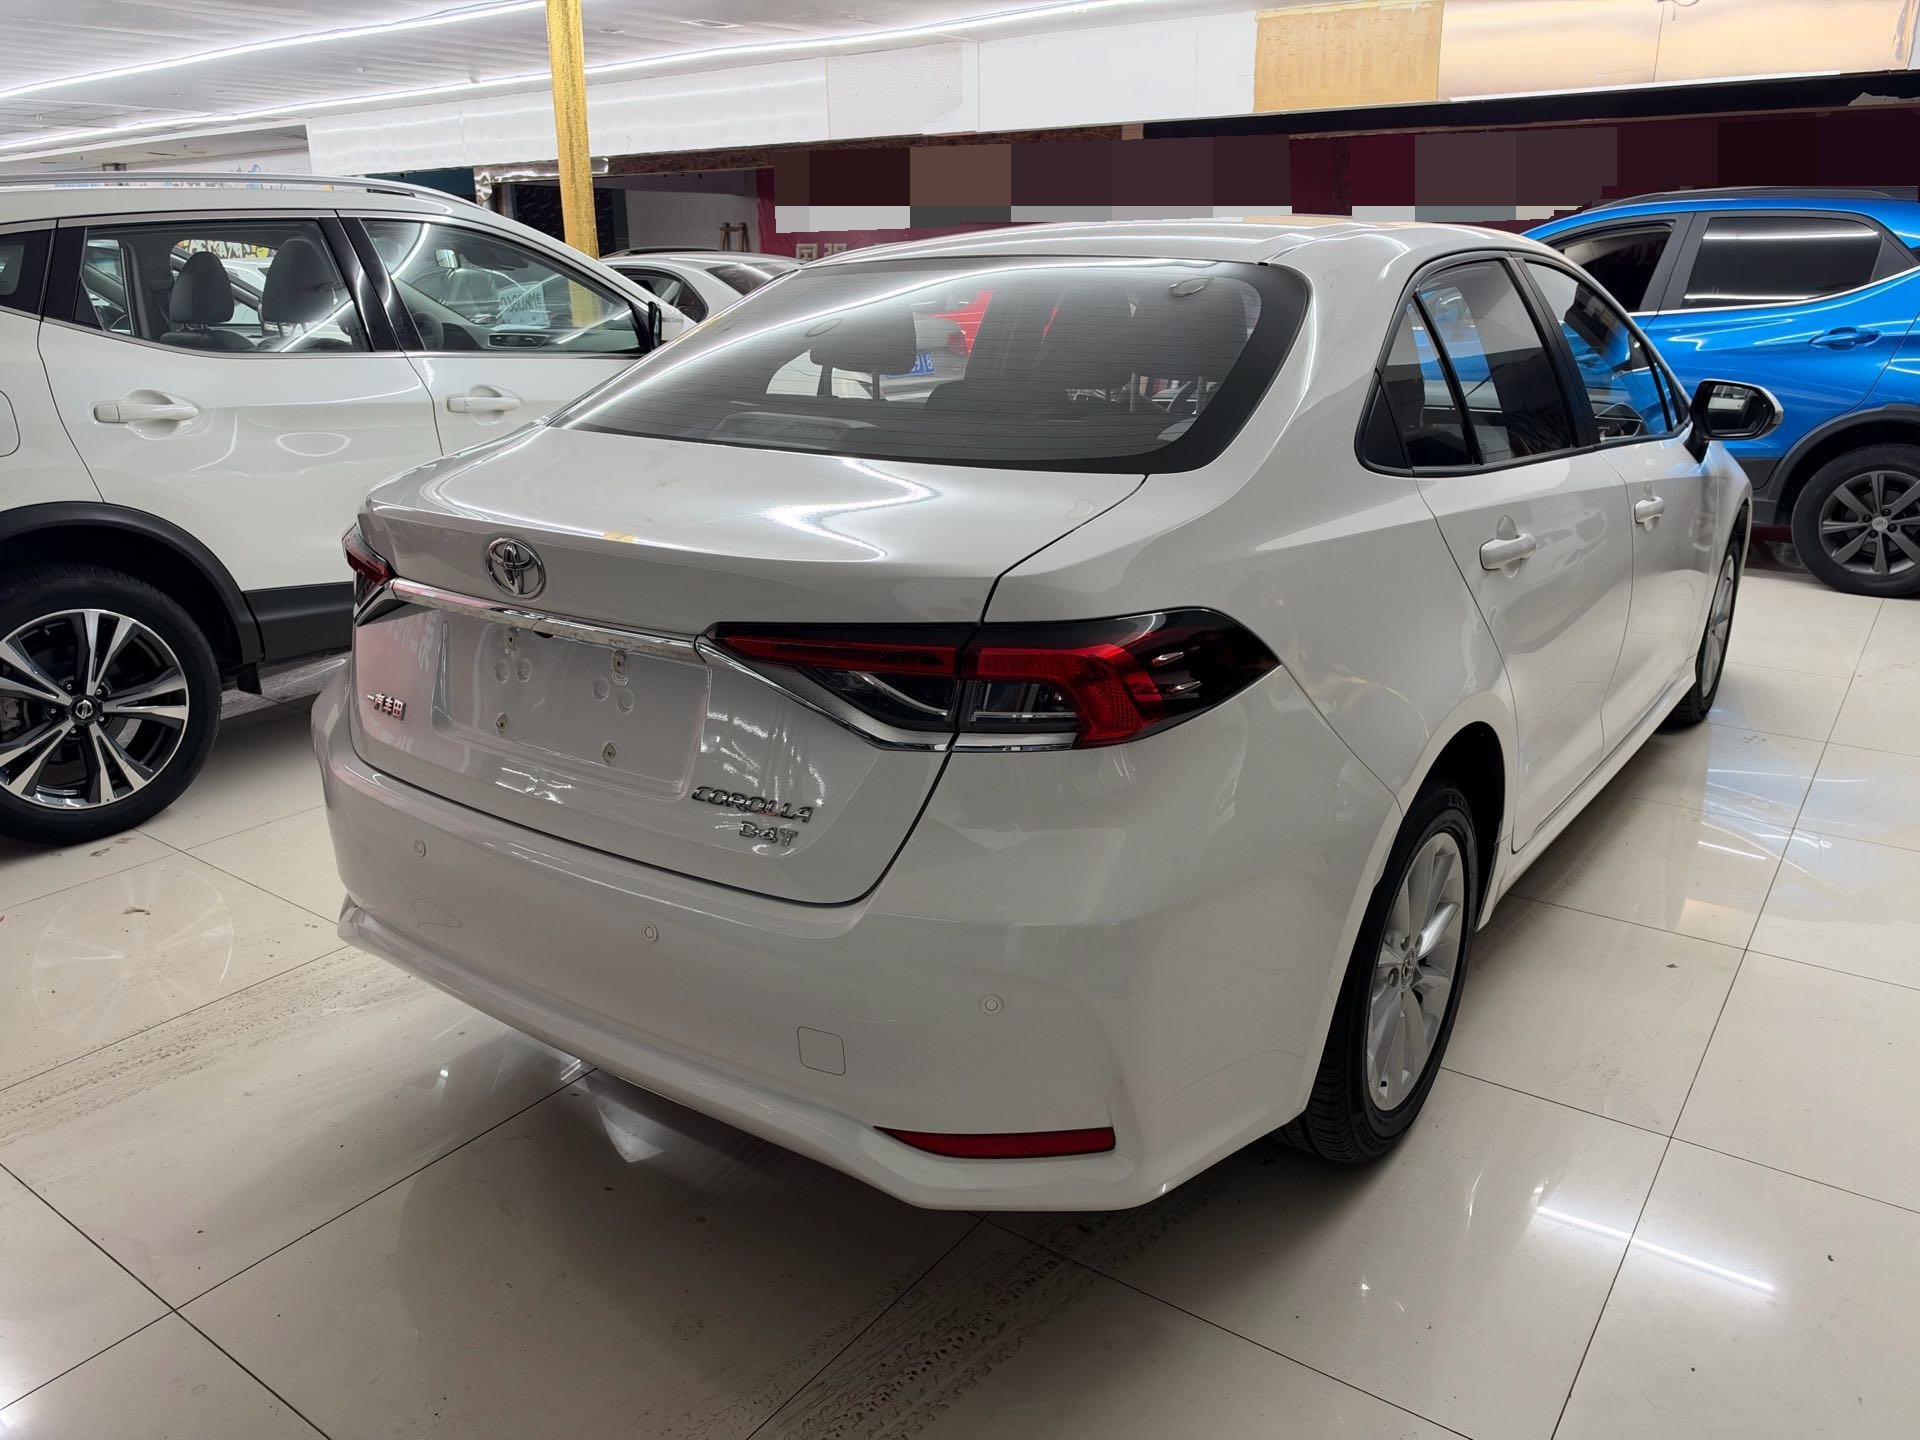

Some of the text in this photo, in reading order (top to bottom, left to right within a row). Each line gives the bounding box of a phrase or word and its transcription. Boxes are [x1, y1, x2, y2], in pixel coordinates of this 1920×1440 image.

[366, 693, 407, 721] 一汽丰田
[692, 786, 814, 823] COROLLA
